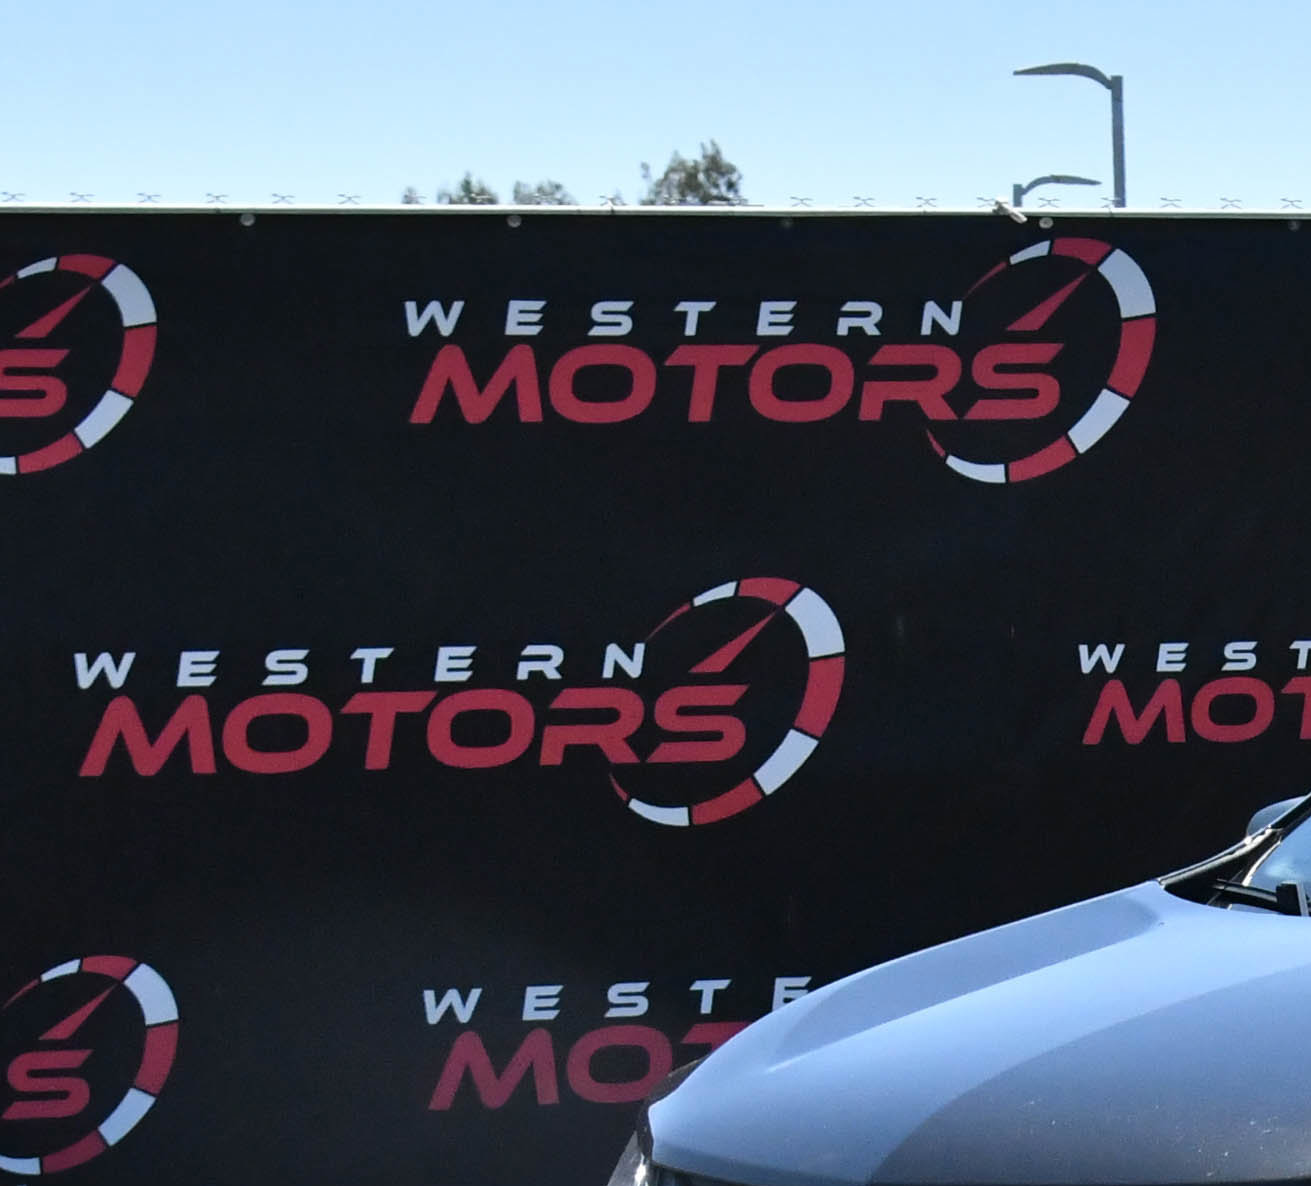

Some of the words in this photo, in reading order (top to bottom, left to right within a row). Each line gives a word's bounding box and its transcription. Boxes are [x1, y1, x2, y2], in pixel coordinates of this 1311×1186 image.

[405, 300, 963, 337] WESTERN
[409, 343, 1064, 424] MOTORS
[74, 642, 645, 689] WESTERN
[79, 684, 750, 777] MOTORS
